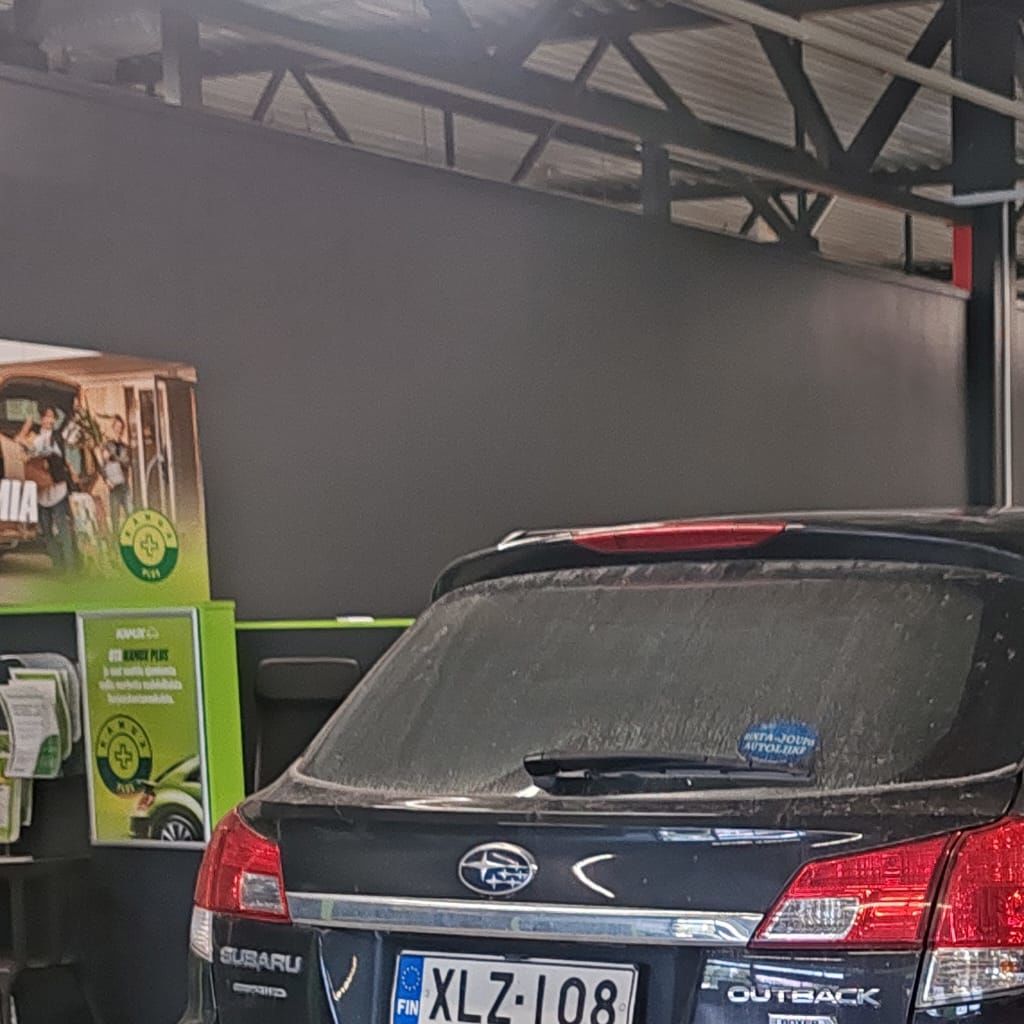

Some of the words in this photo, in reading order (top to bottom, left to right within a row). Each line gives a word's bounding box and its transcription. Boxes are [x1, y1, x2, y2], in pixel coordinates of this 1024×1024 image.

[220, 945, 303, 974] SUBARU
[397, 998, 420, 1016] FIN
[727, 985, 882, 1009] OUTBACK
